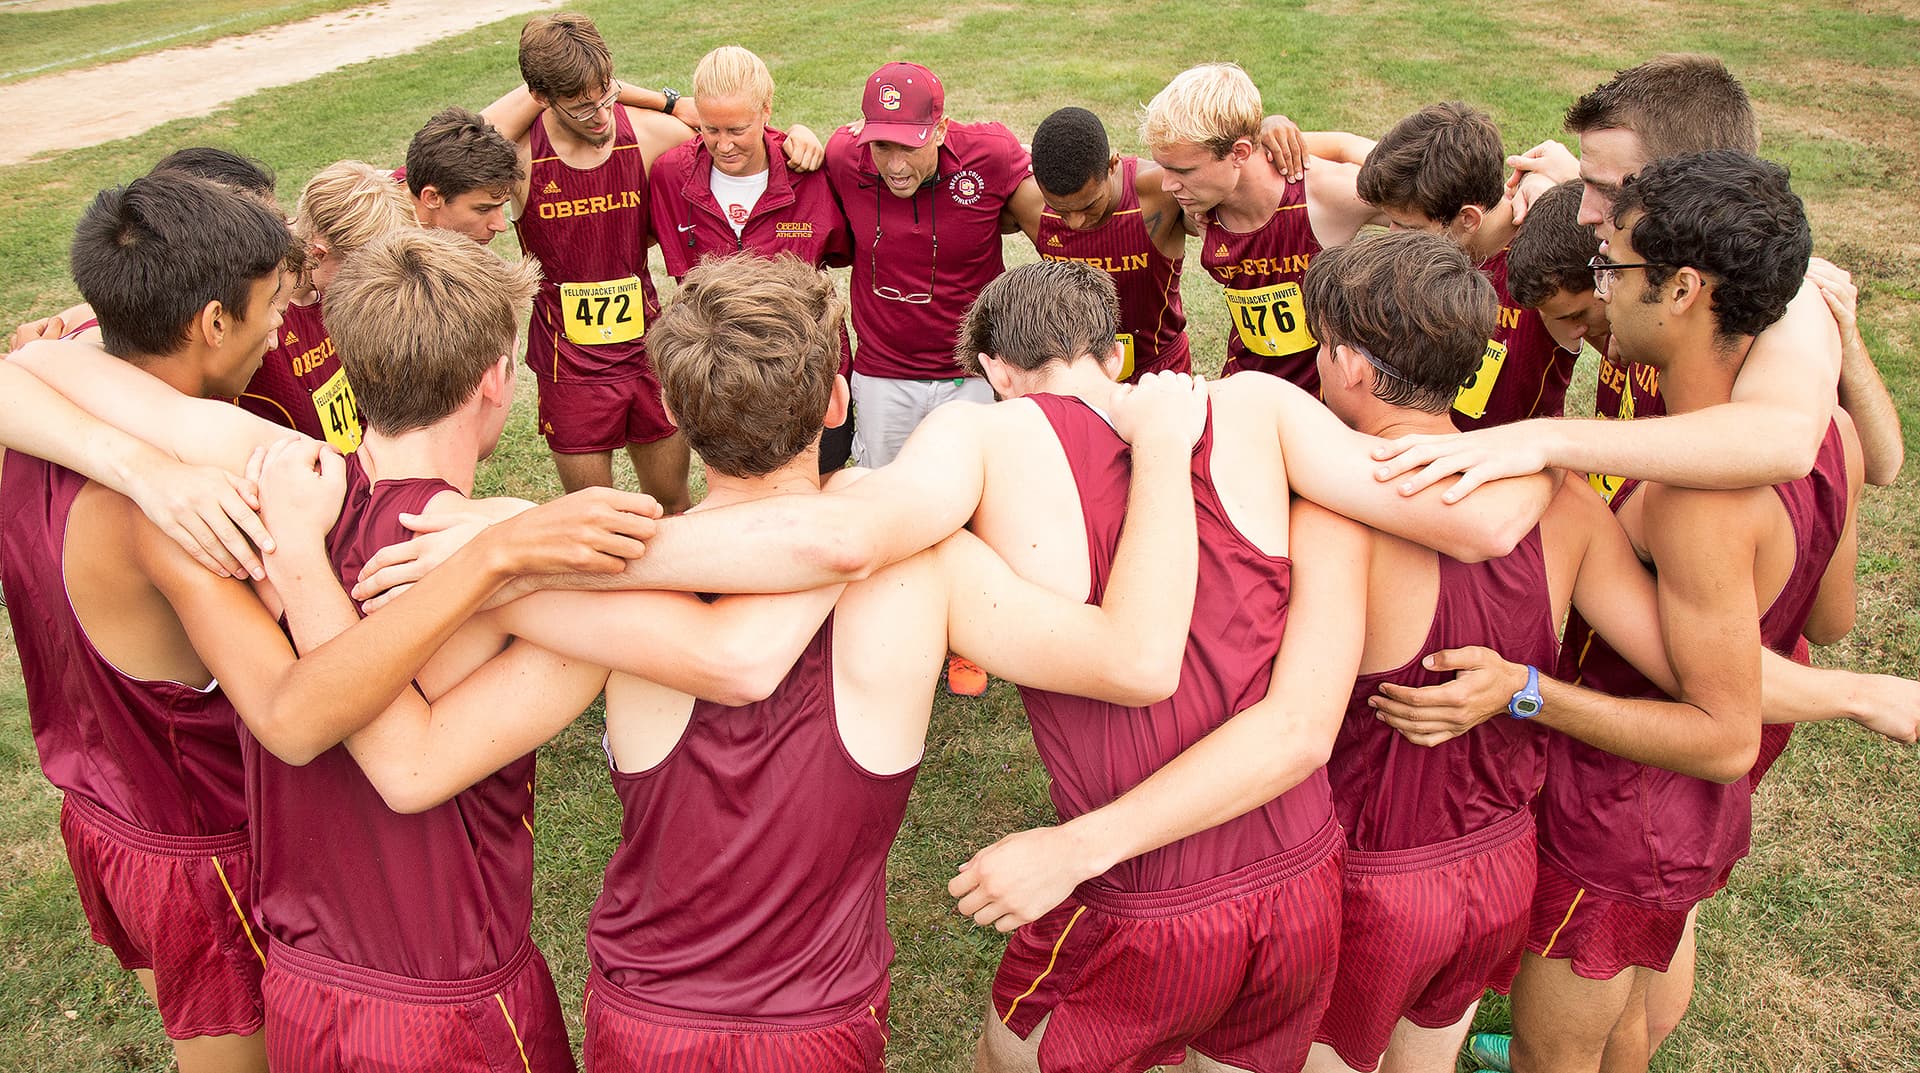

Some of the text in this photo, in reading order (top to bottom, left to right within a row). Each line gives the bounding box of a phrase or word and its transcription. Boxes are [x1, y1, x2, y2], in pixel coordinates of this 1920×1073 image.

[539, 190, 641, 219] OBERLIN
[775, 222, 812, 231] OBERLIN
[1042, 253, 1149, 273] RLIN
[617, 282, 638, 295] INVITE
[1272, 287, 1298, 301] INVITE
[576, 294, 632, 326] 472
[1240, 300, 1296, 337] 476
[292, 336, 336, 377] OBERL
